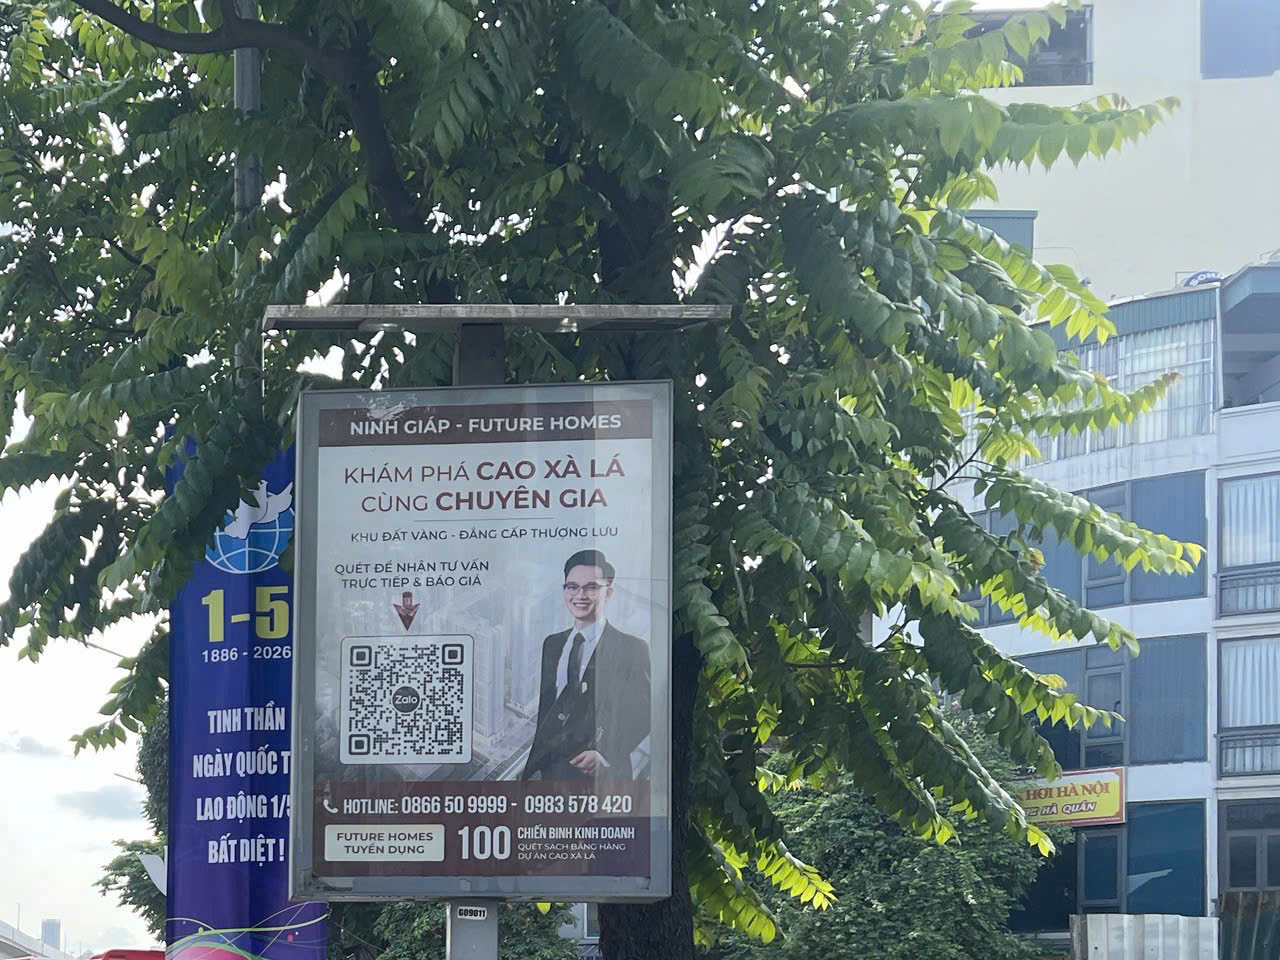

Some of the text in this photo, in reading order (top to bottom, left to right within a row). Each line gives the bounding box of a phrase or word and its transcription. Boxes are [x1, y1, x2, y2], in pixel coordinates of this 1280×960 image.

[350, 420, 398, 435] NINH
[404, 416, 451, 434] GIÁP
[469, 417, 545, 432] FUTURE
[551, 414, 622, 430] HOMES
[345, 453, 625, 484] KHÁM PHÁ CAO XÀ LÁ
[361, 485, 608, 512] CÙNG CHUYÊN GIA
[351, 532, 378, 542] KHU
[382, 528, 408, 541] ĐẤT
[411, 529, 447, 541] VÀNG
[501, 526, 527, 538] CẤP
[592, 526, 618, 537] LƯU
[335, 562, 371, 575] QUÉT
[396, 560, 436, 574] NHẬN
[440, 560, 458, 571] TƯ
[461, 558, 489, 571] VẤN
[341, 574, 482, 591] TRỰC TIẾP & BÁO GIÁ
[201, 586, 290, 642] 1-5
[202, 648, 238, 663] 1886
[253, 646, 291, 660] 2026
[394, 694, 418, 705] Zalo
[208, 701, 285, 733] TINH THẦN
[193, 744, 291, 778] NGÀY QUỐC T
[196, 796, 224, 821] LAO
[227, 790, 268, 823] ĐỘNG
[343, 799, 399, 814] HOTLINE:
[401, 796, 441, 814] 0866
[444, 796, 464, 814] 50
[467, 795, 507, 814] 9999
[524, 795, 564, 813] 0983
[568, 795, 598, 813] 578
[601, 795, 632, 813] 420
[336, 832, 433, 841] FUTURE HOMES
[517, 824, 635, 839] CHIẾN BINH KINH DOANH
[208, 833, 237, 864] BẤT
[240, 834, 276, 866] DIỆT
[344, 842, 425, 856] TUYỂN DỤNG
[457, 825, 511, 860] 100
